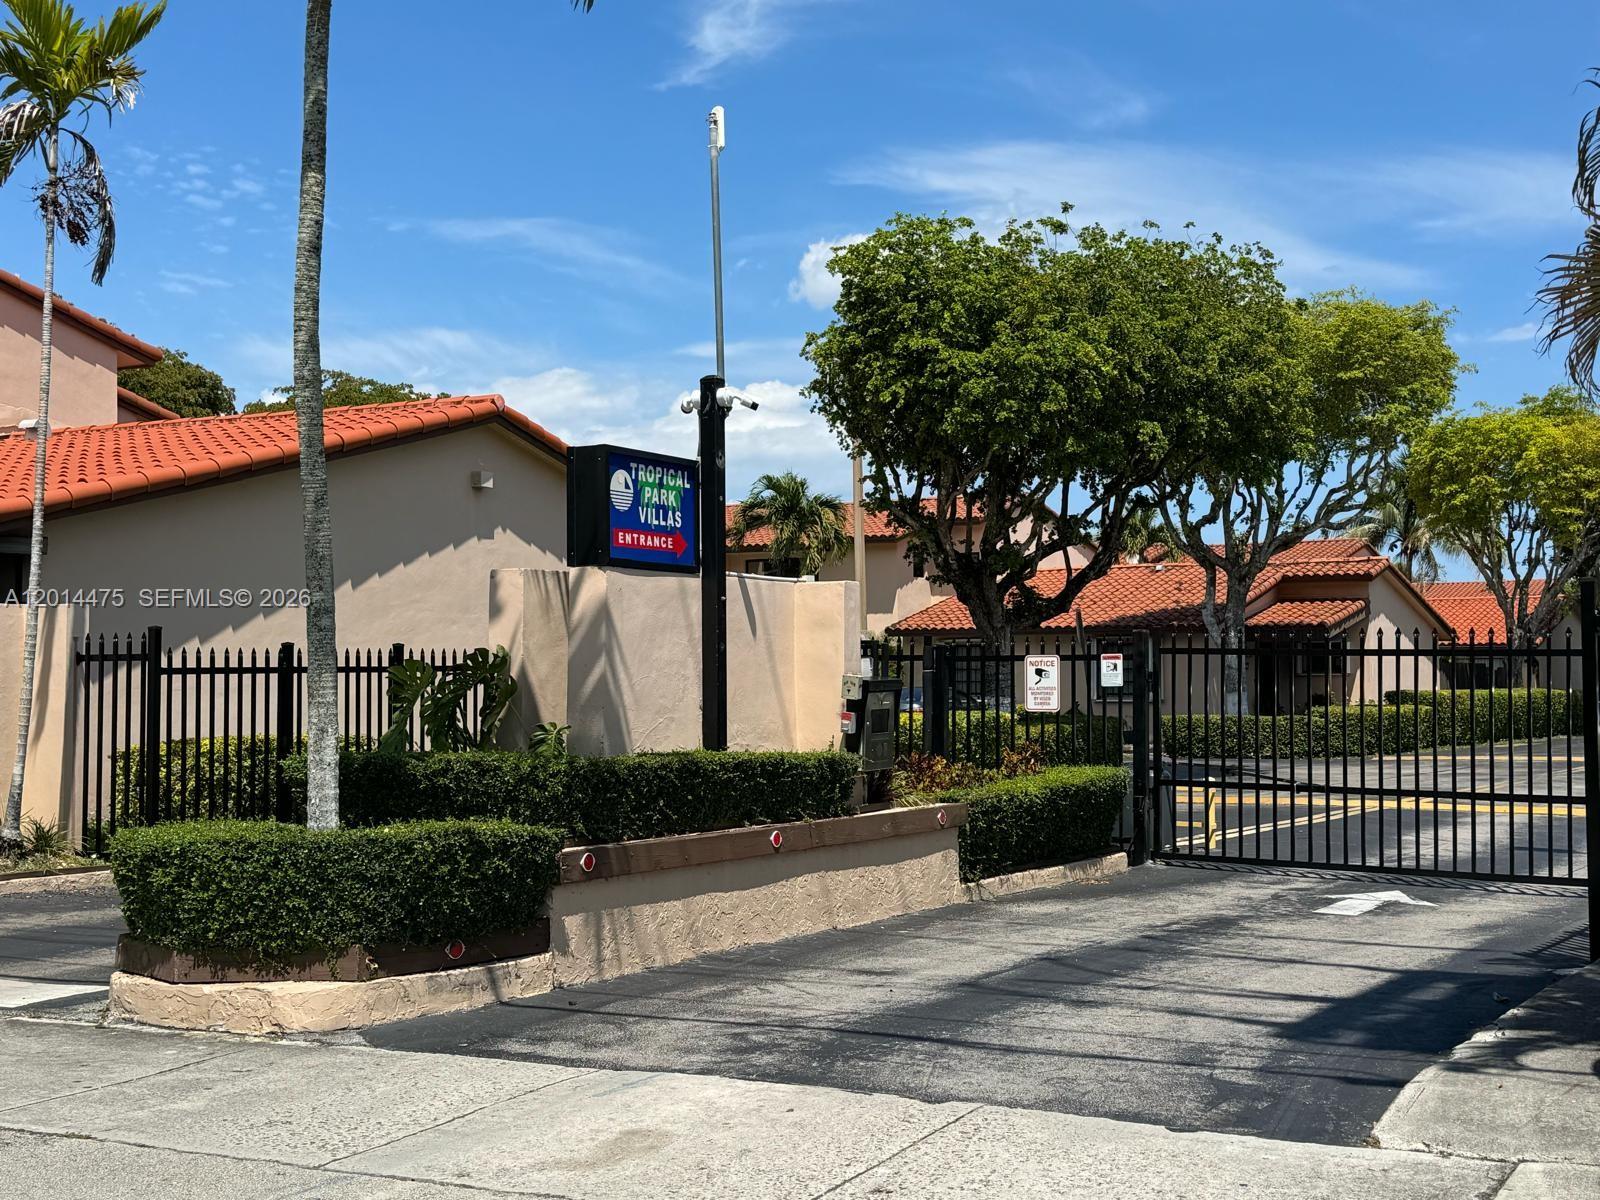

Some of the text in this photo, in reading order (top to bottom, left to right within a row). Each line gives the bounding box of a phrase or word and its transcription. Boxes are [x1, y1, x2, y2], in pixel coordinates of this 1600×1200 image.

[630, 462, 691, 489] TROPICAL
[644, 486, 677, 507] PARK
[638, 506, 682, 528] VILLAS
[618, 532, 673, 548] ENTRANCE
